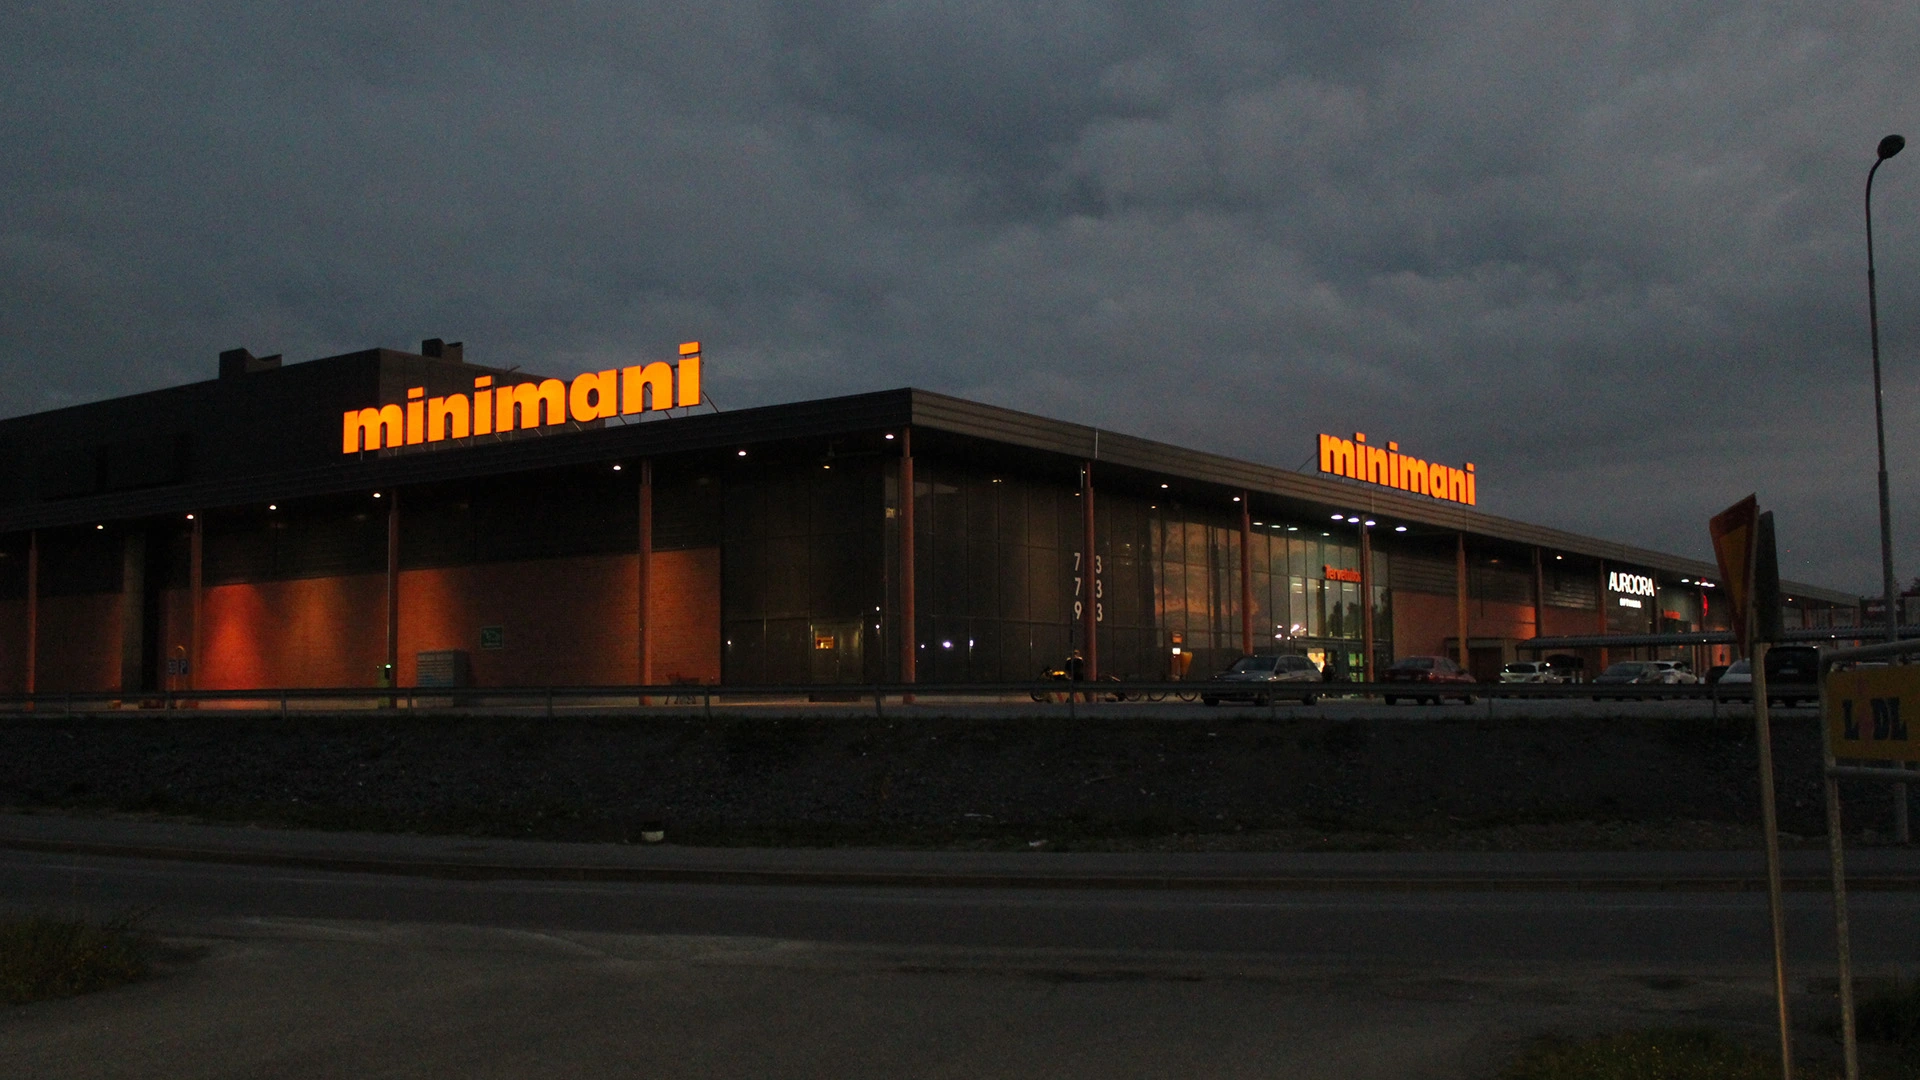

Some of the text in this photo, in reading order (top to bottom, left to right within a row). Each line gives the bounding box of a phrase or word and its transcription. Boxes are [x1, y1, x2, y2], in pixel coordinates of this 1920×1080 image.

[343, 341, 701, 454] minimani
[1319, 432, 1477, 506] minimani
[1608, 571, 1655, 597] AUROORA
